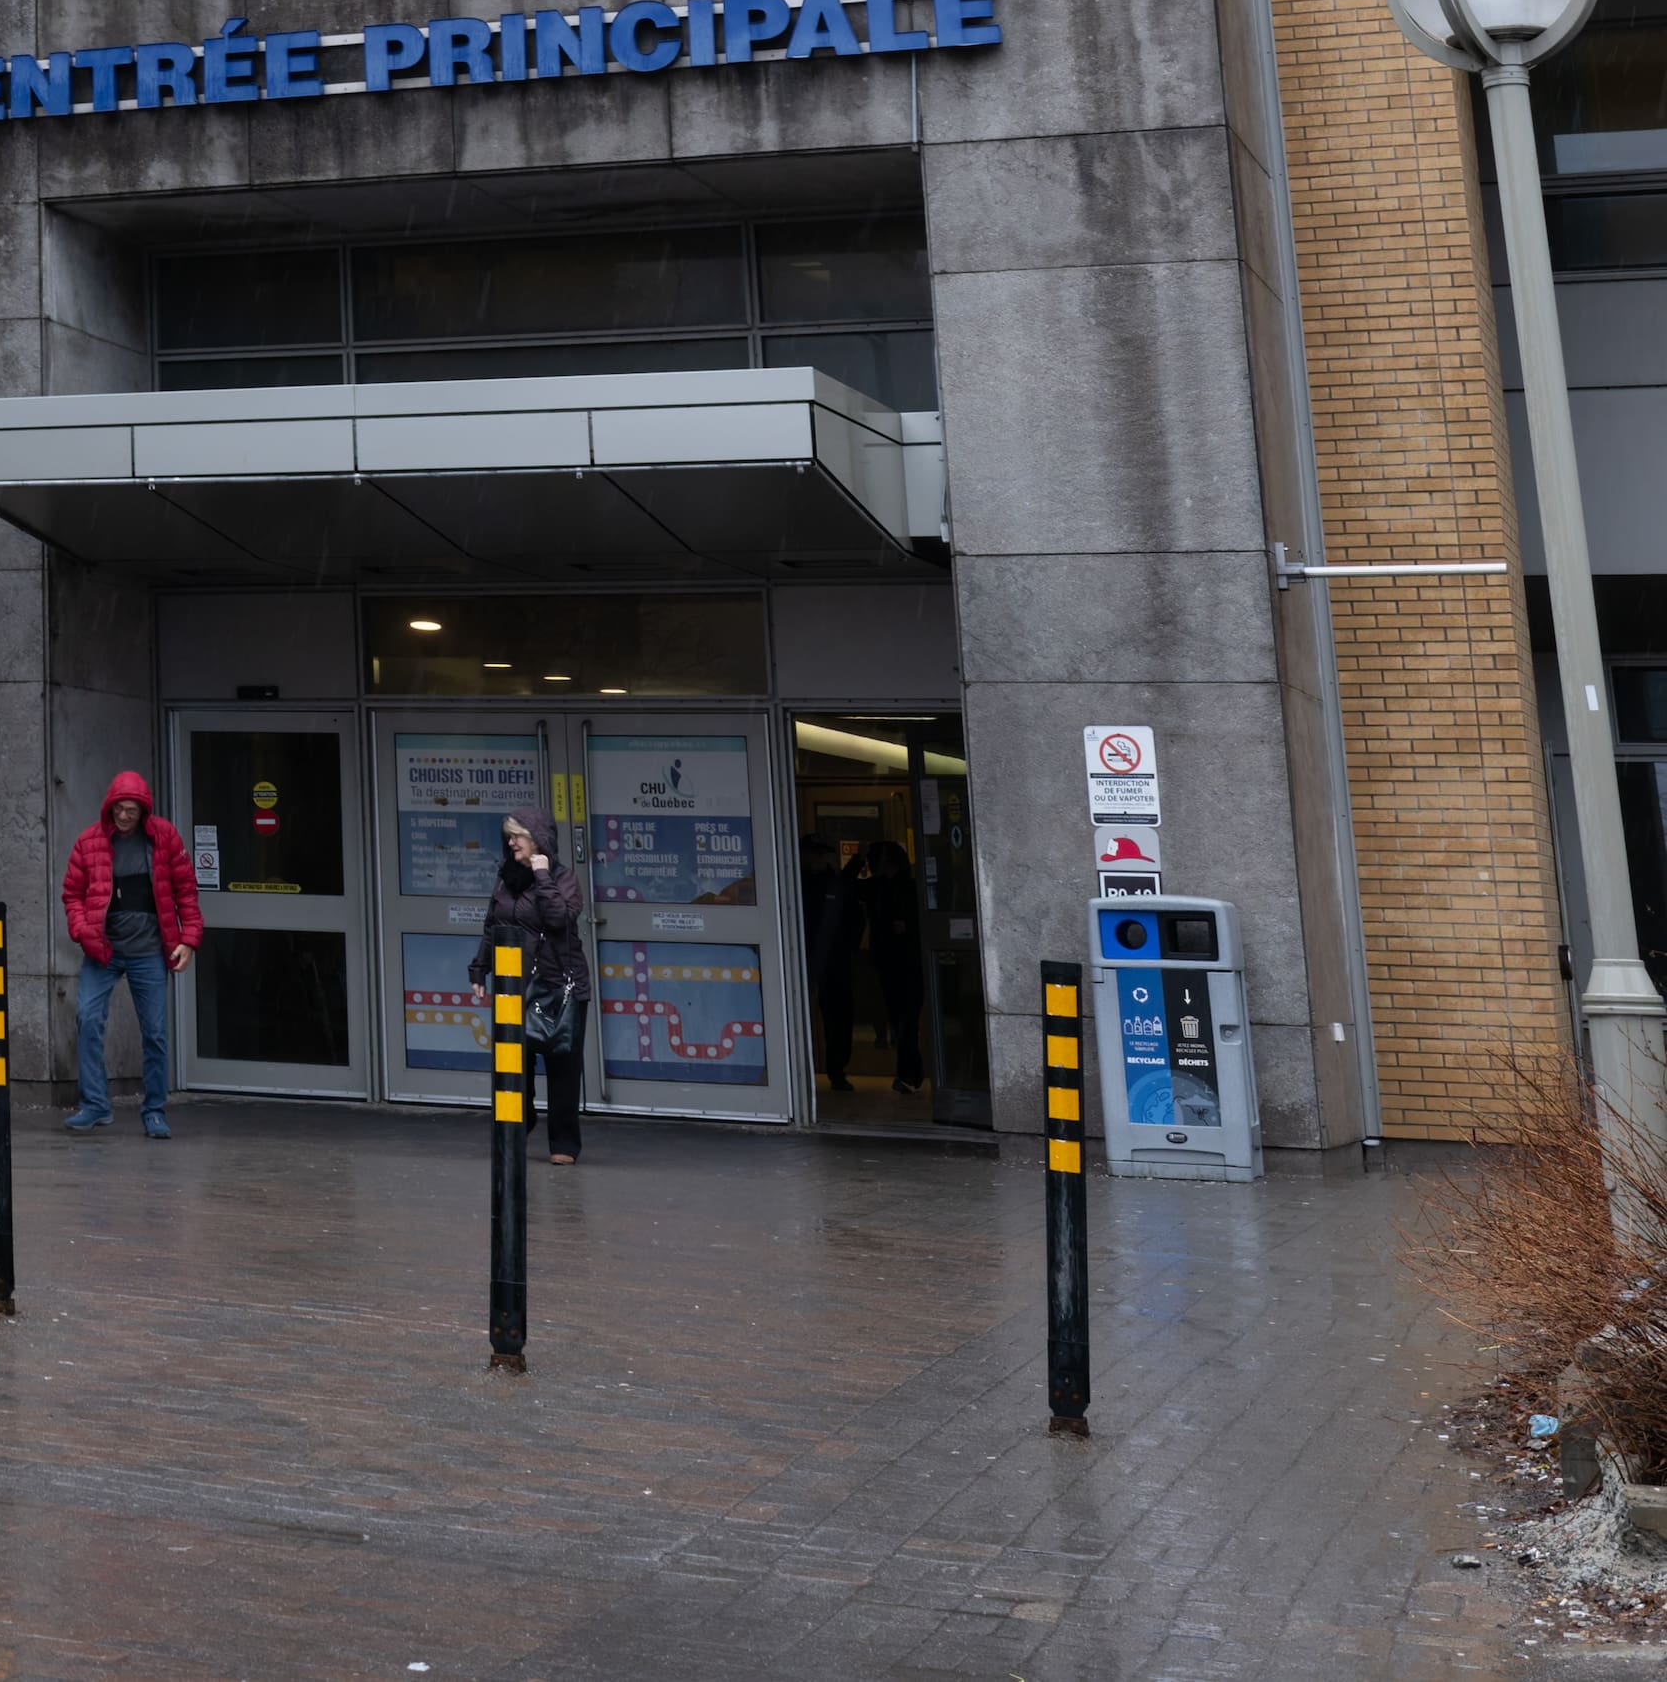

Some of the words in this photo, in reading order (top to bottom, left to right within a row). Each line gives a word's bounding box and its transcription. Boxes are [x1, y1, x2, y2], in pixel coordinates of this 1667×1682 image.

[409, 768, 463, 783] CHOISIS
[411, 786, 422, 797] Ta
[426, 786, 488, 798] destination
[491, 788, 535, 800] carrière
[640, 782, 666, 794] CHU
[652, 797, 695, 808] Québec
[1127, 1056, 1165, 1065] RECYCLAGE
[1178, 1057, 1209, 1066] DÉCHETS
